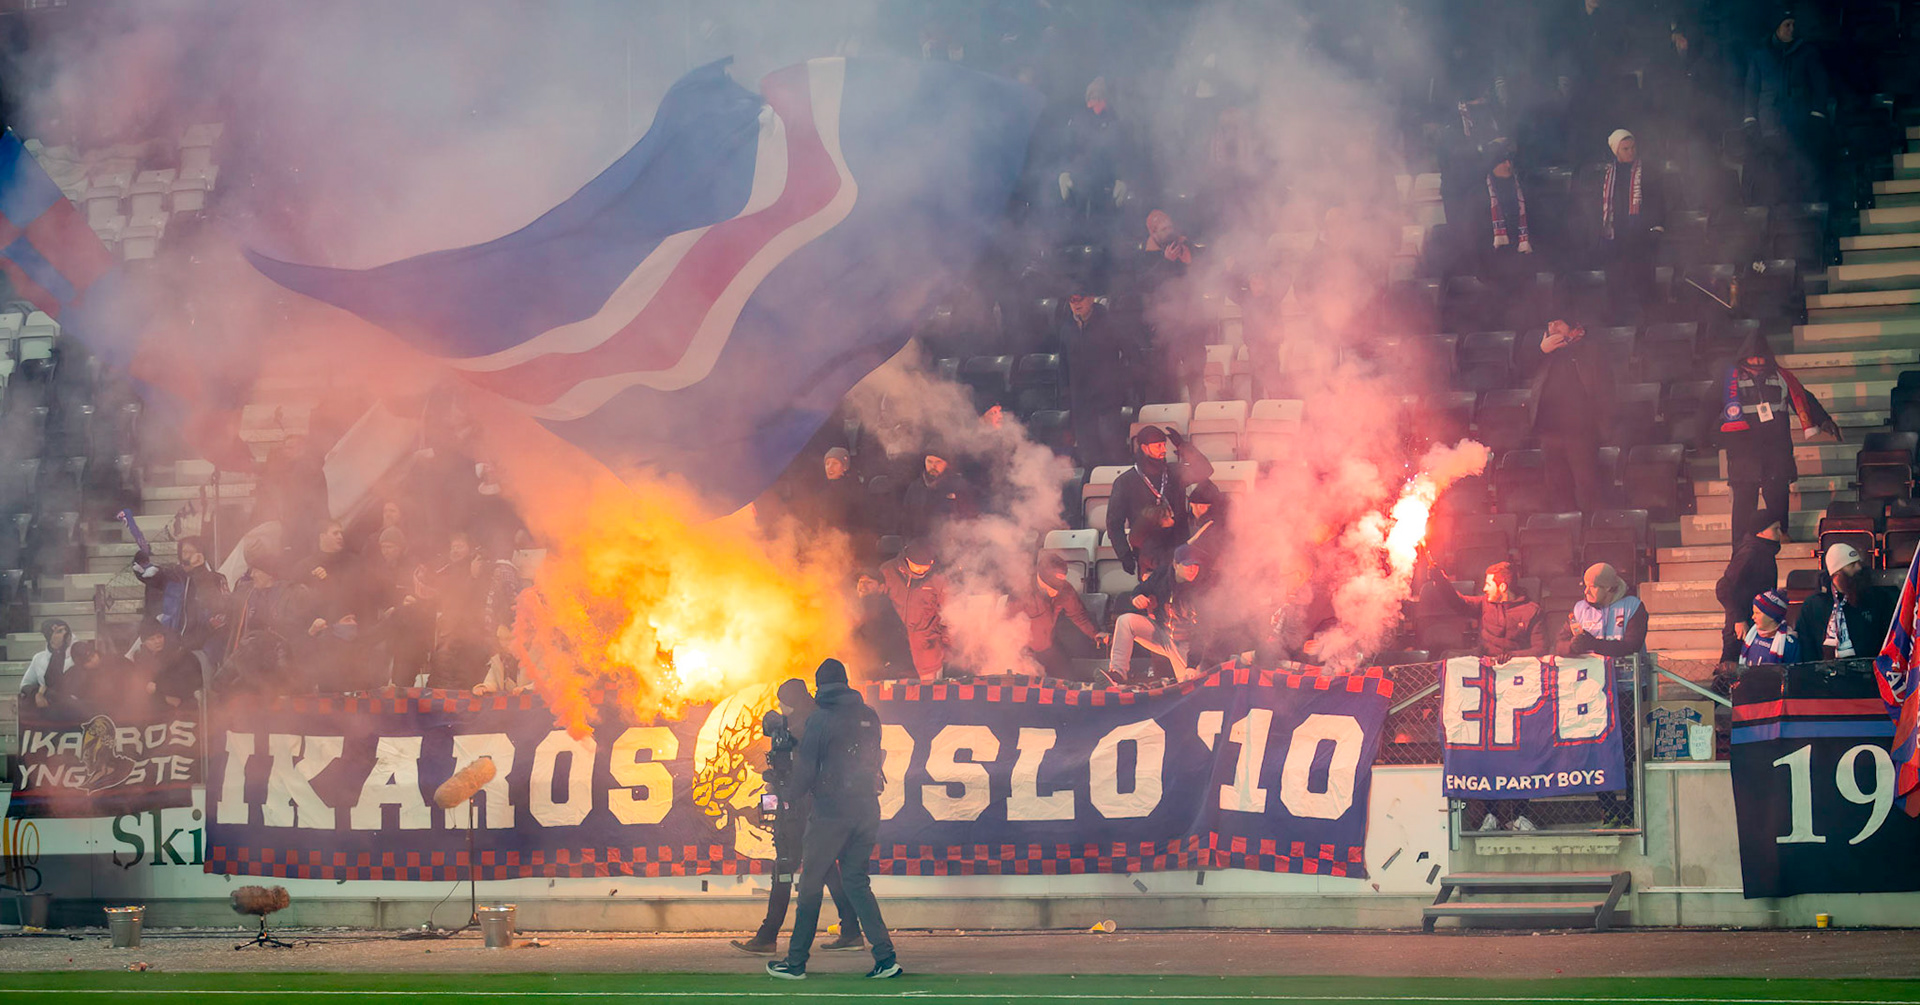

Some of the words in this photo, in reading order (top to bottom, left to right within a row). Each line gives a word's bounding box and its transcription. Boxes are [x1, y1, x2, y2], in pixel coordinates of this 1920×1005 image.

[1442, 654, 1612, 748] EPB
[217, 726, 679, 829] IKAROS
[1446, 774, 1492, 791] ENGA
[1495, 772, 1554, 791] PARTY
[1557, 769, 1605, 787] BOYS
[1773, 744, 1896, 845] 19
[112, 809, 205, 870] Ski
